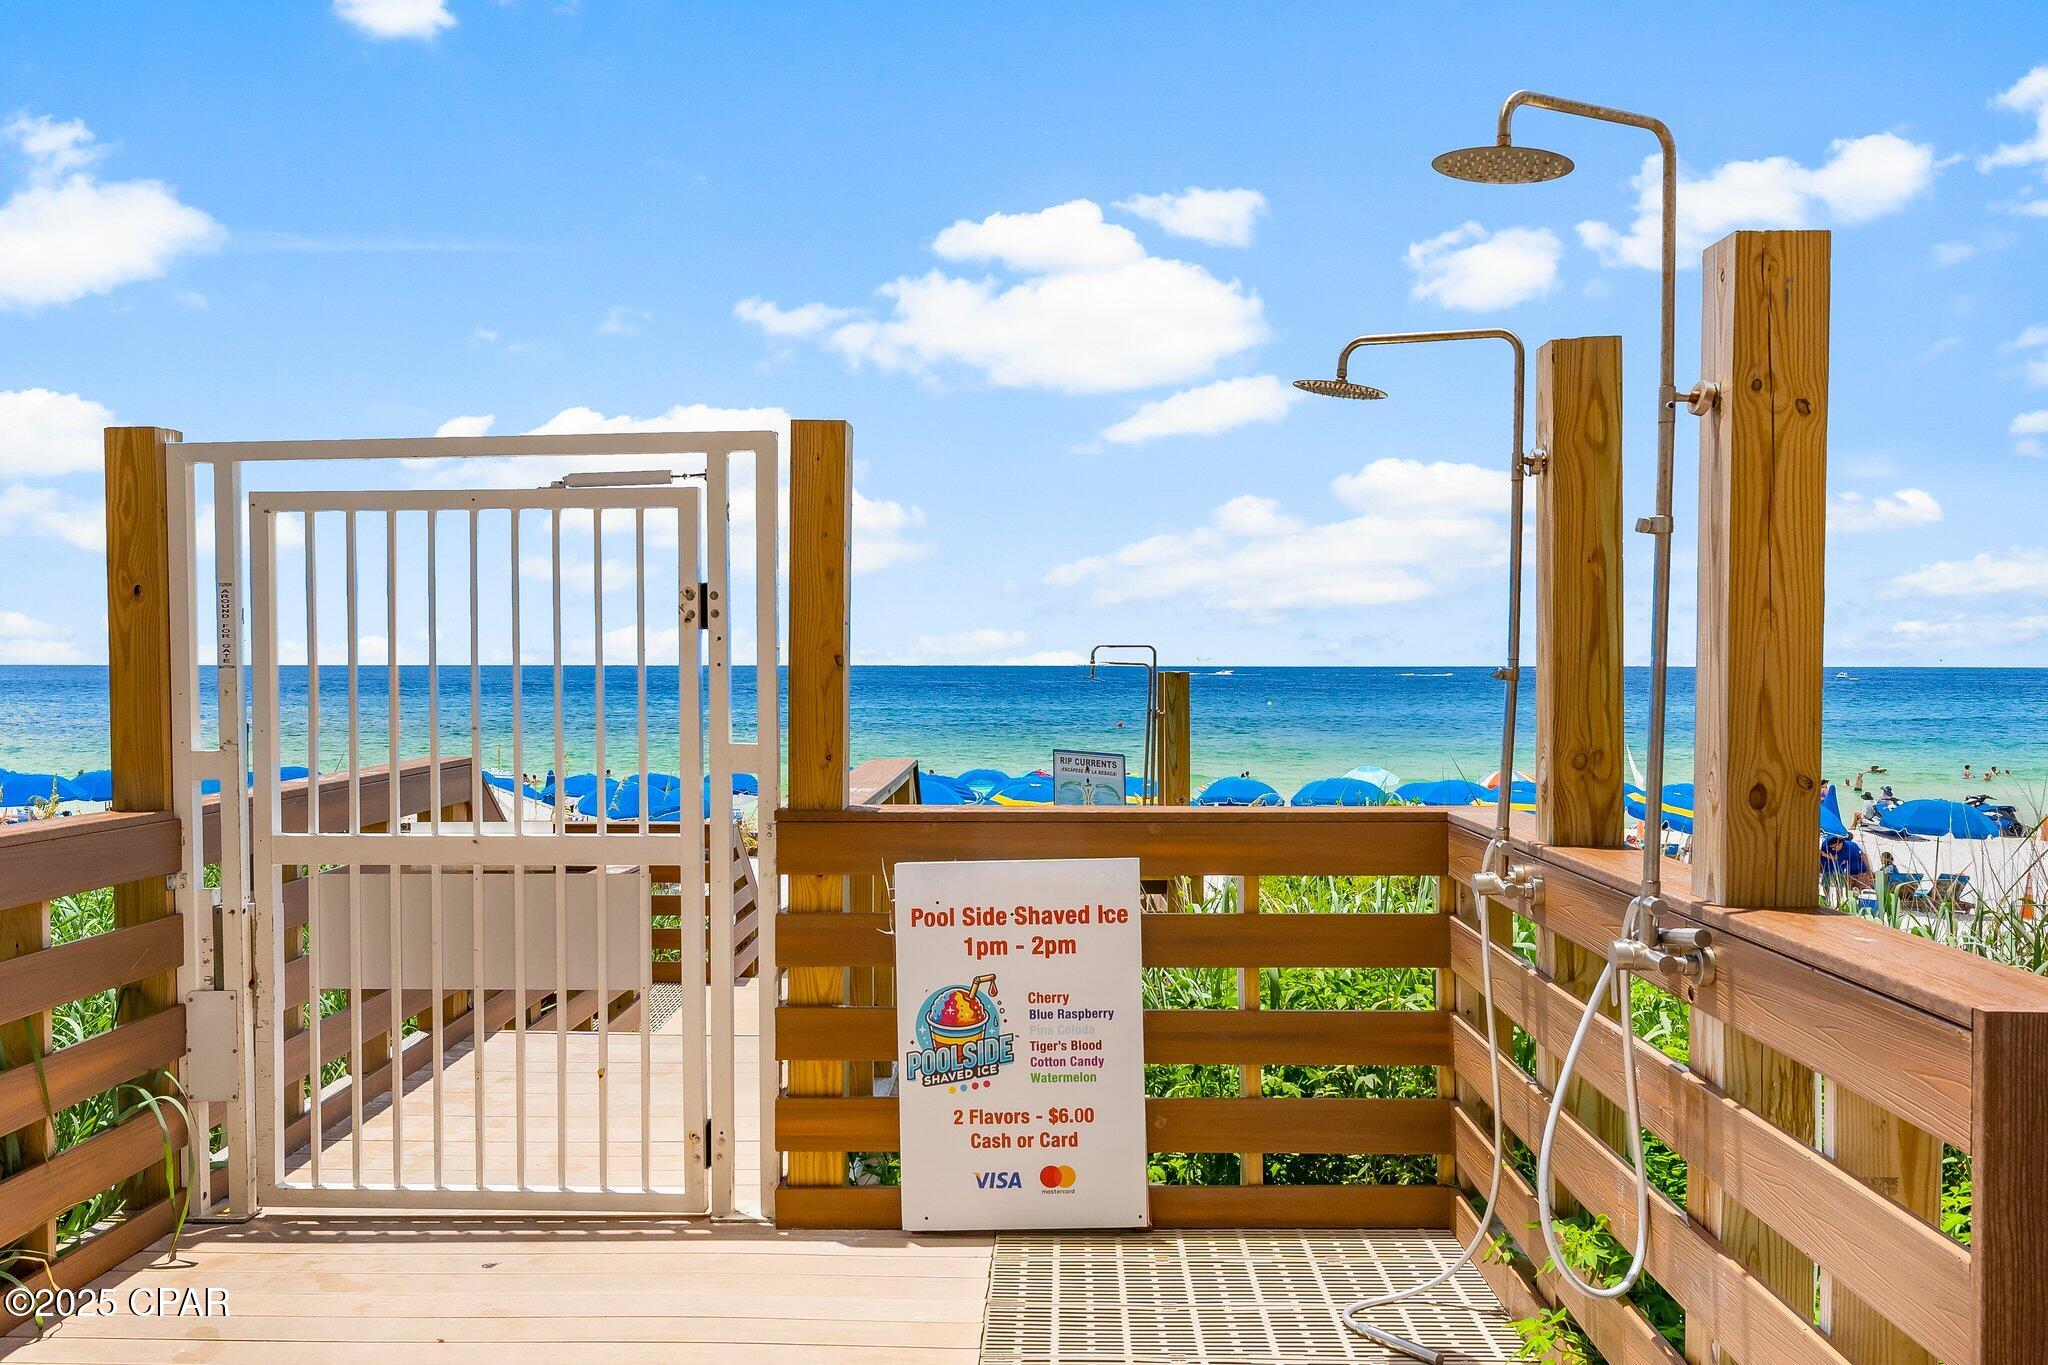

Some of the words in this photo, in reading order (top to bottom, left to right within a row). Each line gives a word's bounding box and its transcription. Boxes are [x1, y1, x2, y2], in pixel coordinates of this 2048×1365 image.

[221, 588, 230, 619] AROUND
[222, 623, 231, 639] FOR
[222, 643, 231, 664] GATE
[1060, 757, 1072, 765] RIP
[1075, 758, 1117, 769] CURRENTS
[911, 908, 955, 927] Pool
[962, 907, 1007, 926] Side
[1014, 905, 1090, 925] Shaved
[1097, 904, 1129, 924] Ice
[964, 937, 1008, 959] 1pm
[1031, 936, 1077, 958] 2pm
[1028, 992, 1069, 1005] Cherry
[1029, 1009, 1054, 1020] Blue
[1057, 1009, 1114, 1021] Raspberry
[1030, 1041, 1067, 1053] Tiger's
[1070, 1040, 1102, 1051] Blood
[906, 1032, 1015, 1080] POOLSIDE
[1030, 1057, 1066, 1067] Cotton
[1070, 1056, 1104, 1069] Candy
[924, 1069, 973, 1086] SHAVED
[977, 1064, 998, 1077] ICE
[1030, 1072, 1097, 1083] Watermelon
[953, 1109, 964, 1125] 2
[969, 1109, 1030, 1125] Flavors
[1048, 1107, 1095, 1125] $6.00
[970, 1132, 1012, 1149] Cash
[1017, 1135, 1035, 1148] or
[1039, 1131, 1078, 1148] Card
[973, 1172, 1022, 1189] VISA
